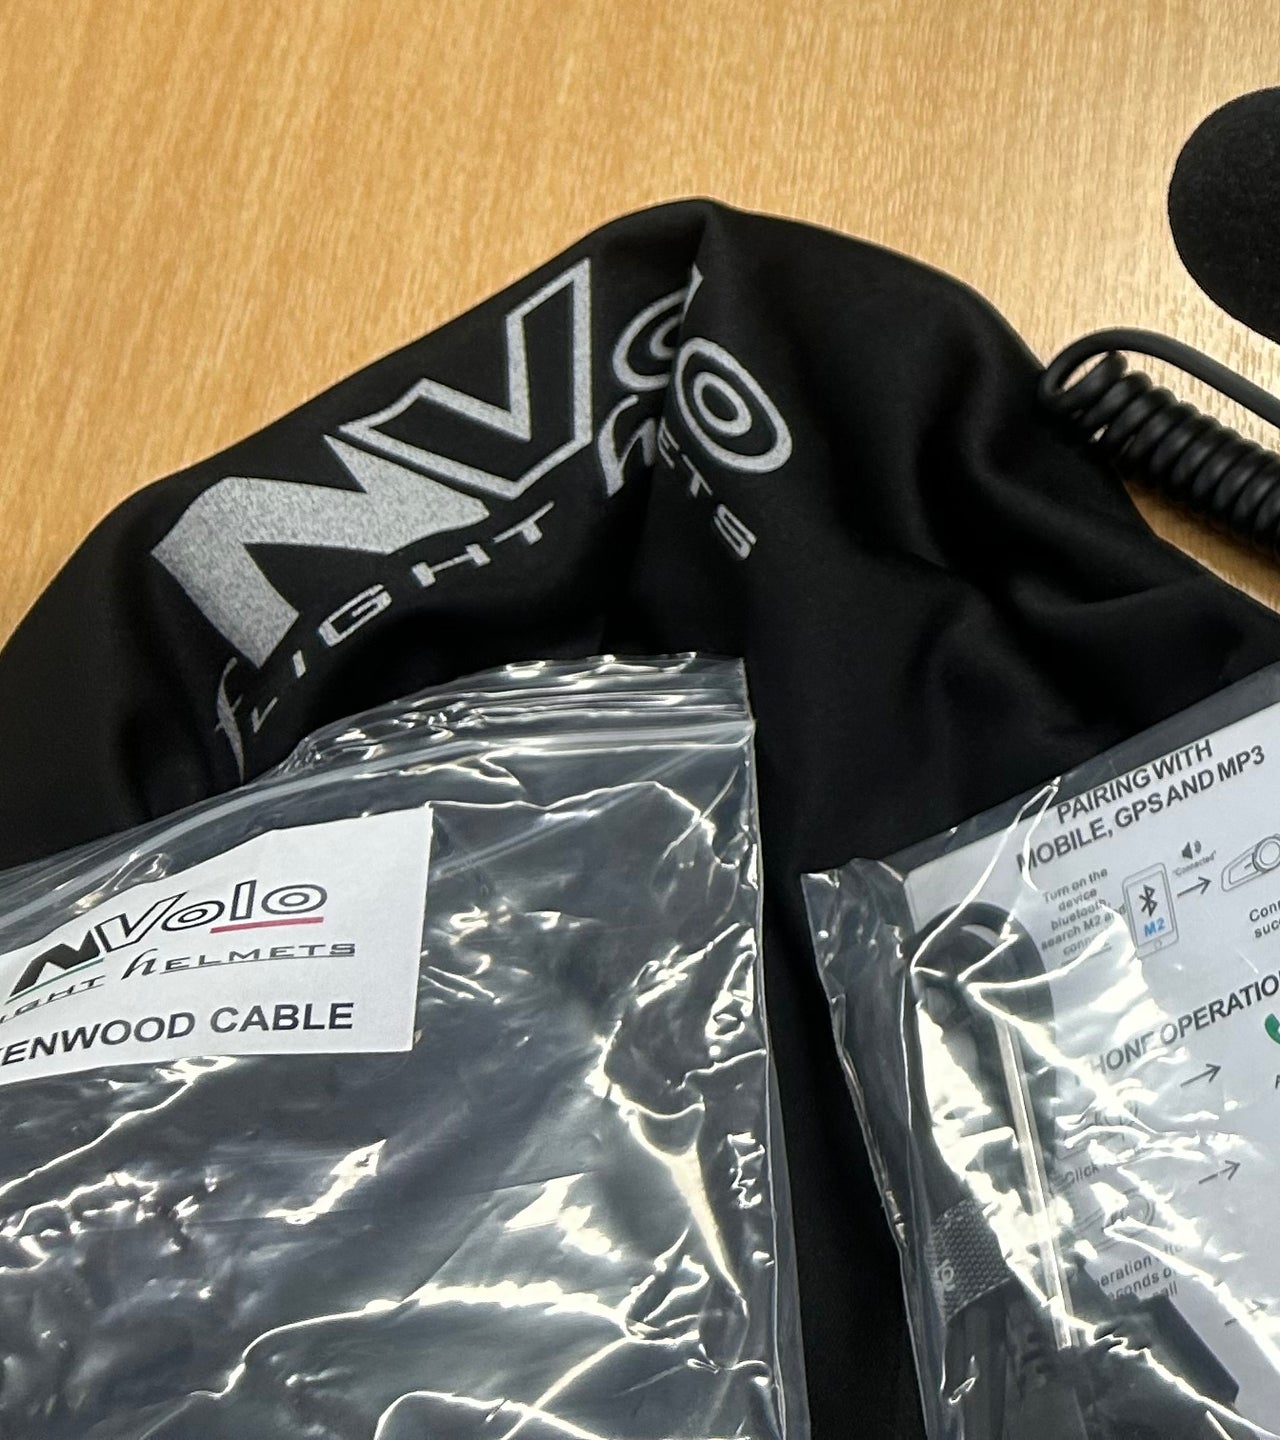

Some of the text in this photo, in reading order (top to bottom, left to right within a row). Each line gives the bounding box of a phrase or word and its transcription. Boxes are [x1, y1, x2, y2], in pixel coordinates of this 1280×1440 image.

[150, 258, 793, 670] NVoo
[1056, 739, 1213, 824] PAIRING WITH
[1015, 744, 1266, 874] MOBILE, GPS AND MP3
[1042, 868, 1109, 905] Turn on the
[1057, 887, 1098, 913] device
[9, 879, 328, 998] NVolo
[1041, 923, 1082, 952] search
[1083, 915, 1102, 932] M2
[1143, 916, 1167, 938] M2
[210, 1002, 354, 1034] CABLE
[1097, 1254, 1153, 1289] eration
